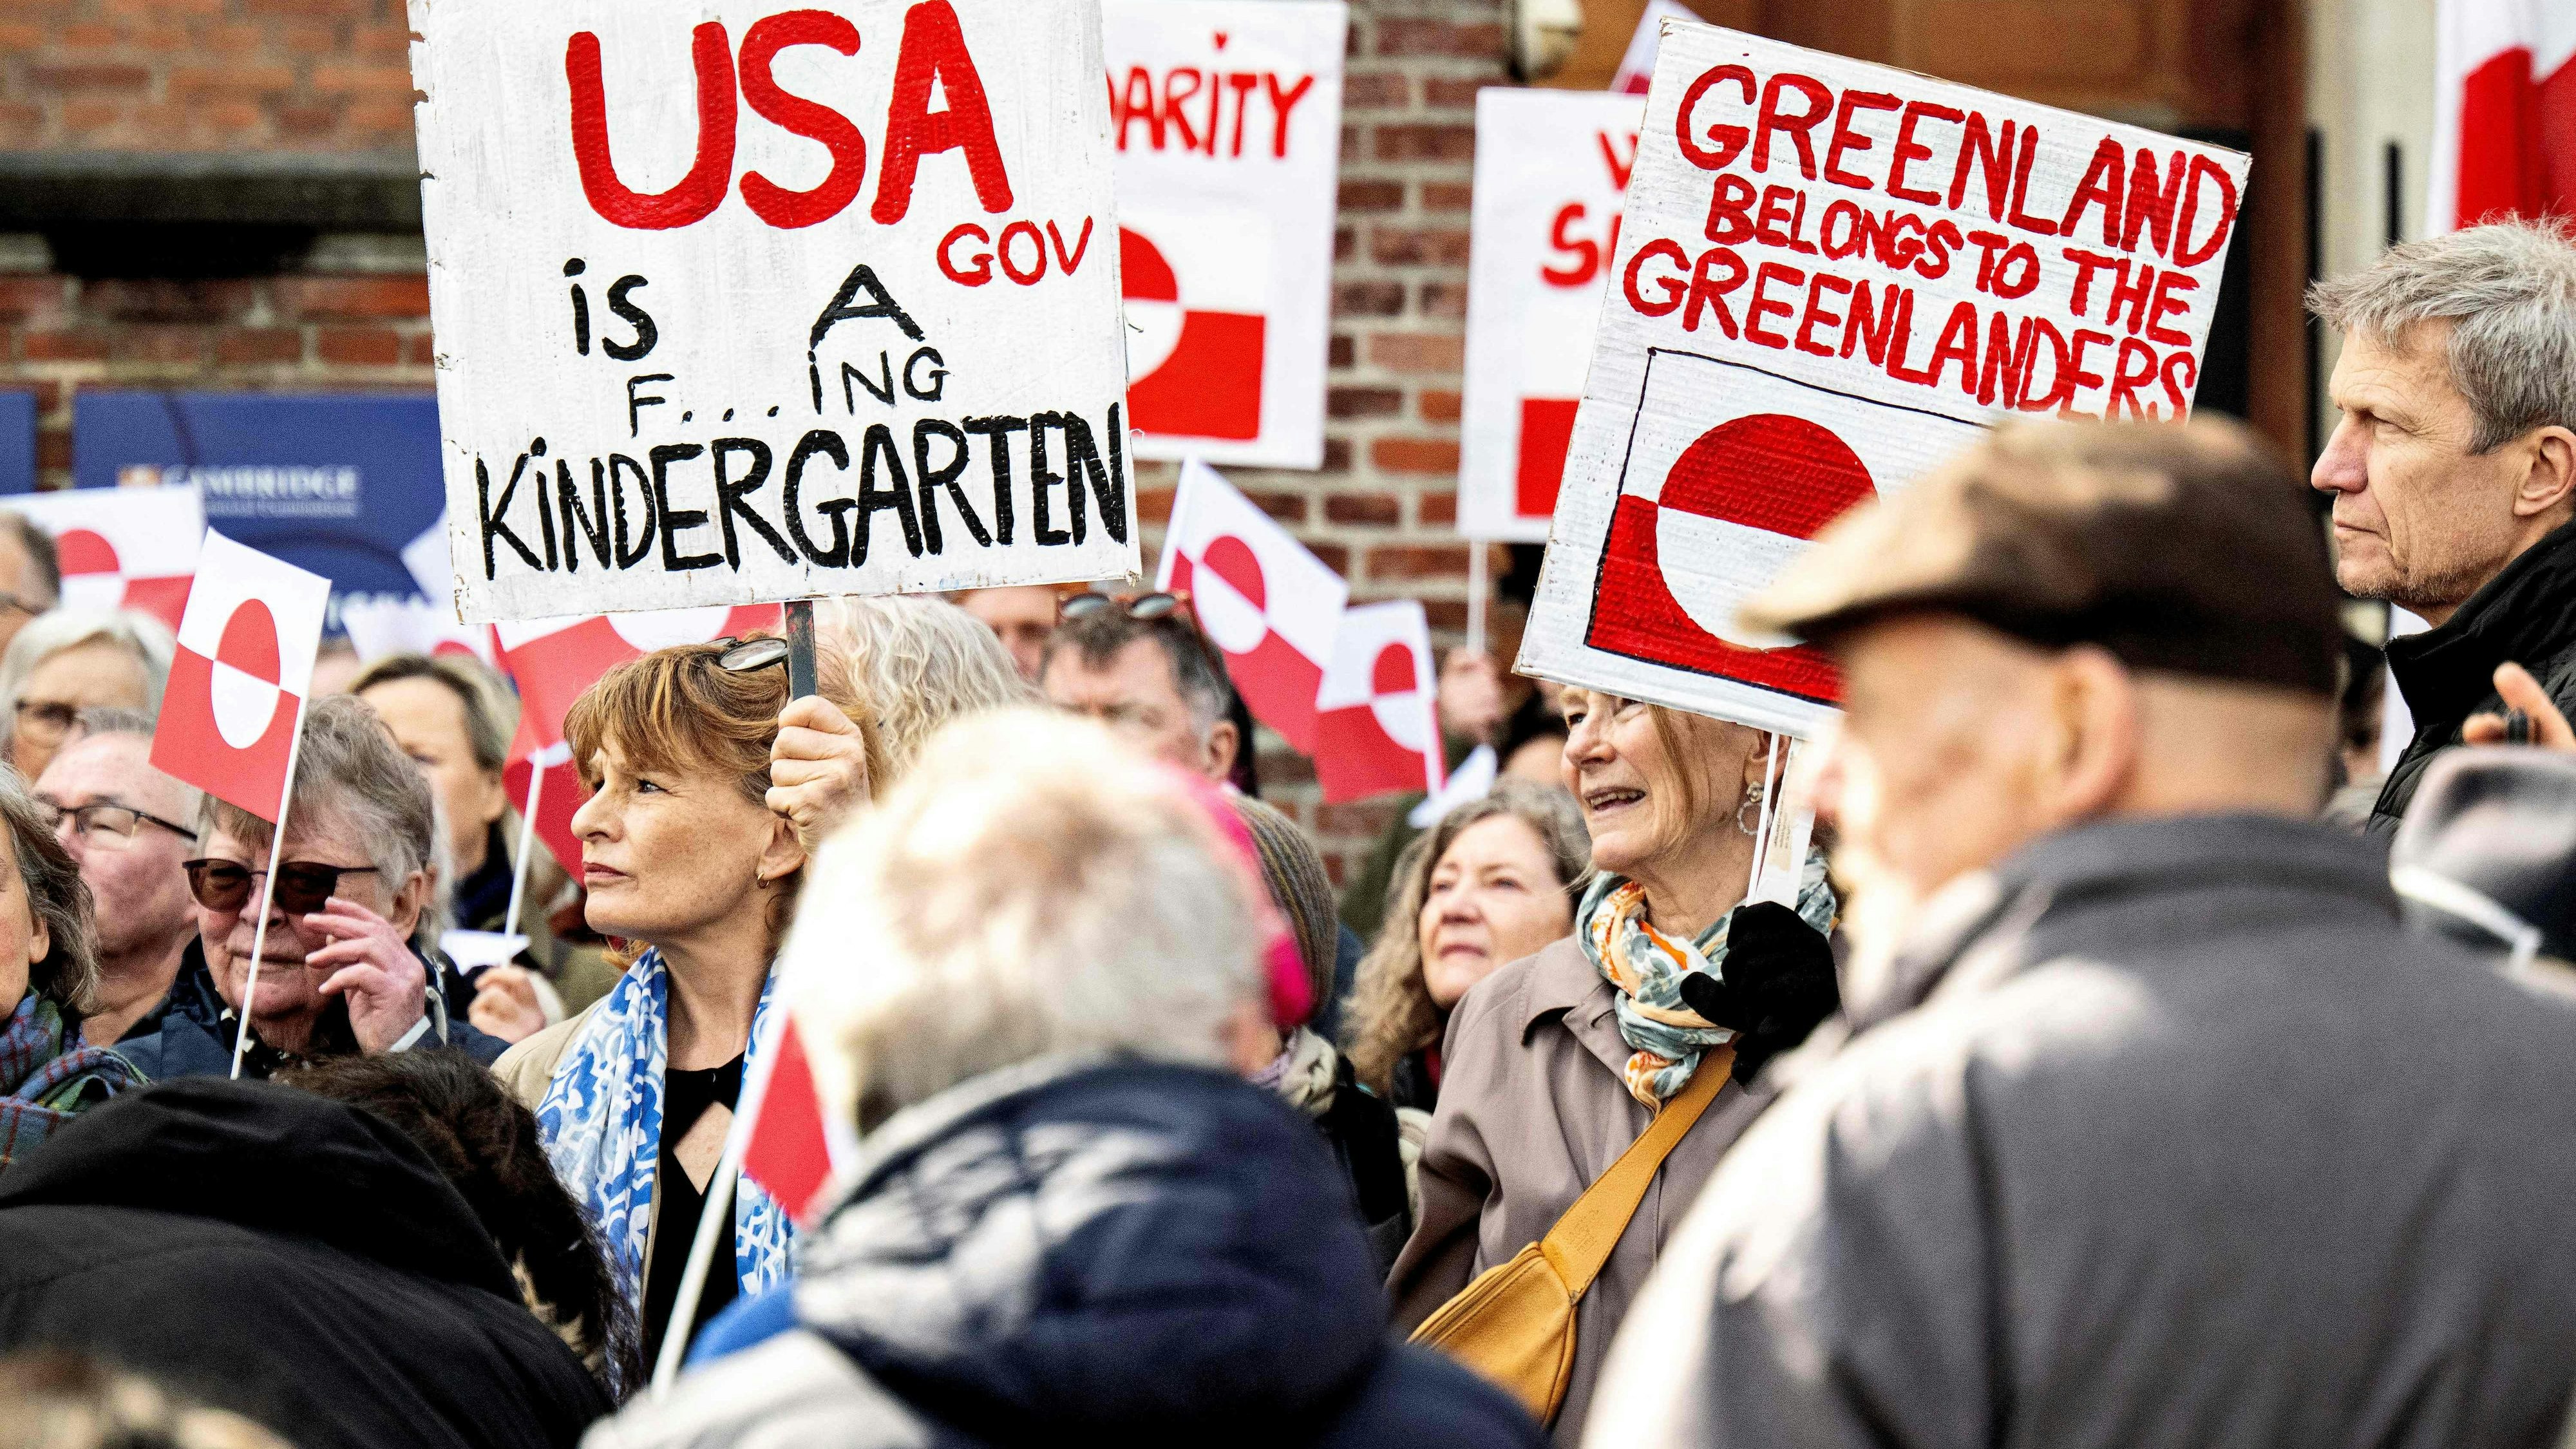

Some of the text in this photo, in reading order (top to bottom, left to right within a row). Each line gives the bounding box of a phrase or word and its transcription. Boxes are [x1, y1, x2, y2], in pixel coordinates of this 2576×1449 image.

[566, 0, 1014, 230] USA
[1106, 66, 1314, 158] ARITY
[1676, 65, 2237, 267] GREENLAND
[810, 264, 925, 348] A
[937, 217, 1093, 287] GOV
[1624, 238, 2197, 423] GREENLANDERS
[1705, 174, 2199, 346] BELONGS TO THE
